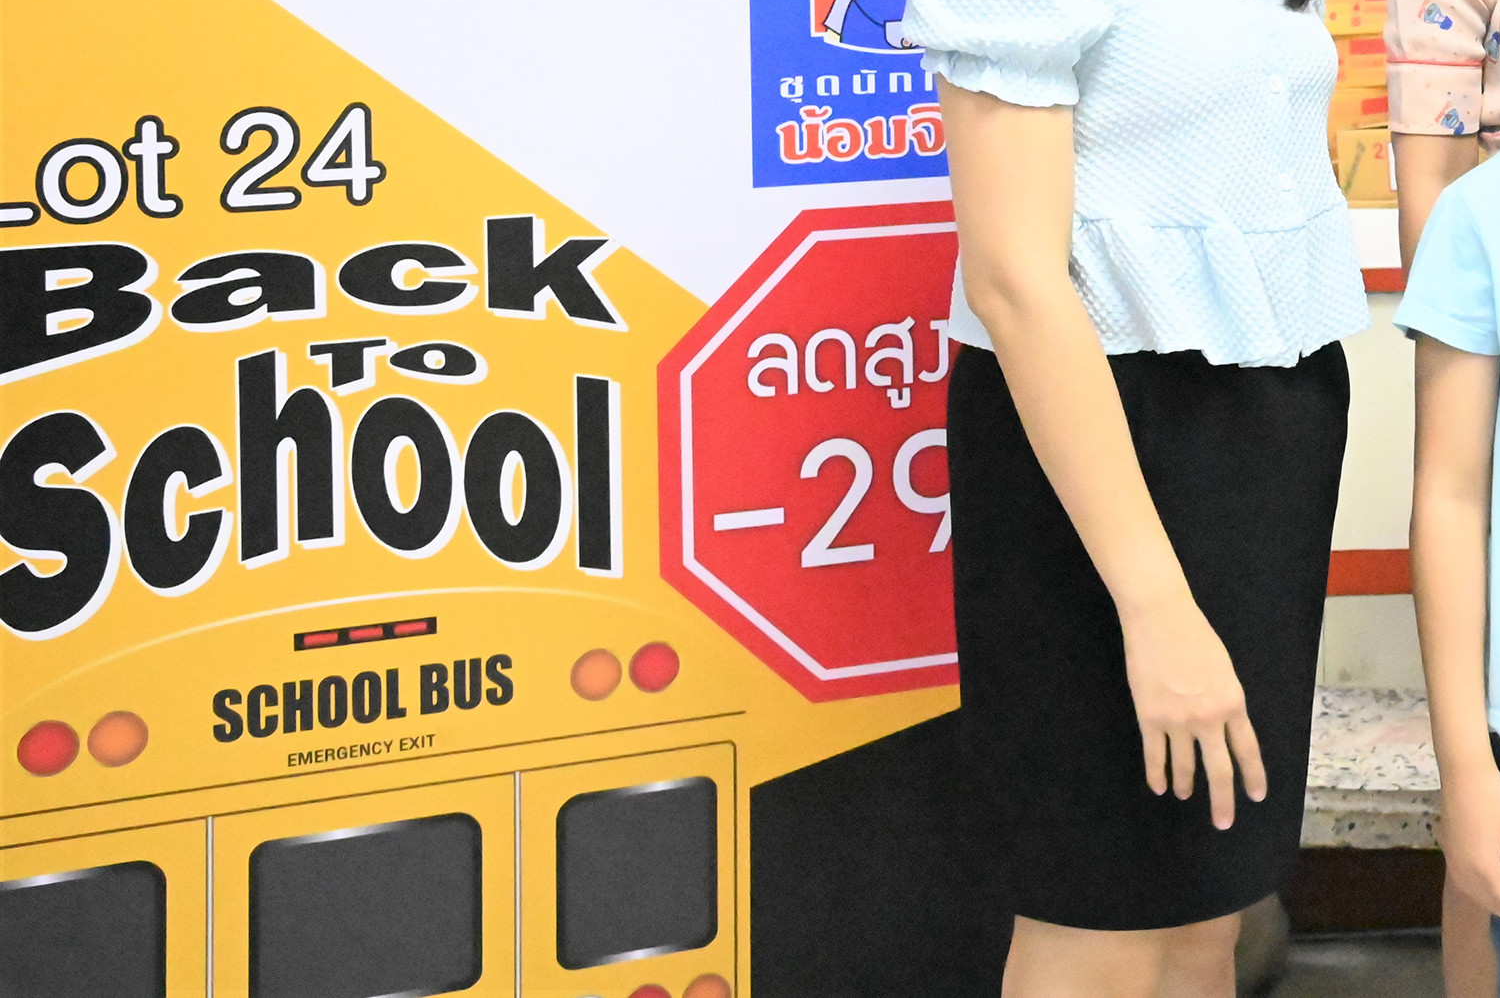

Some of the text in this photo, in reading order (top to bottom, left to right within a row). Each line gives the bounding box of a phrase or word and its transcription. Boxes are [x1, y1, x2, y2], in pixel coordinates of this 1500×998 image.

[0, 102, 387, 228] ot 24
[0, 215, 628, 385] Back
[0, 349, 624, 642] School
[212, 653, 514, 743] SCHOOL BUS
[287, 733, 436, 768] EMERGENCY EXIT
